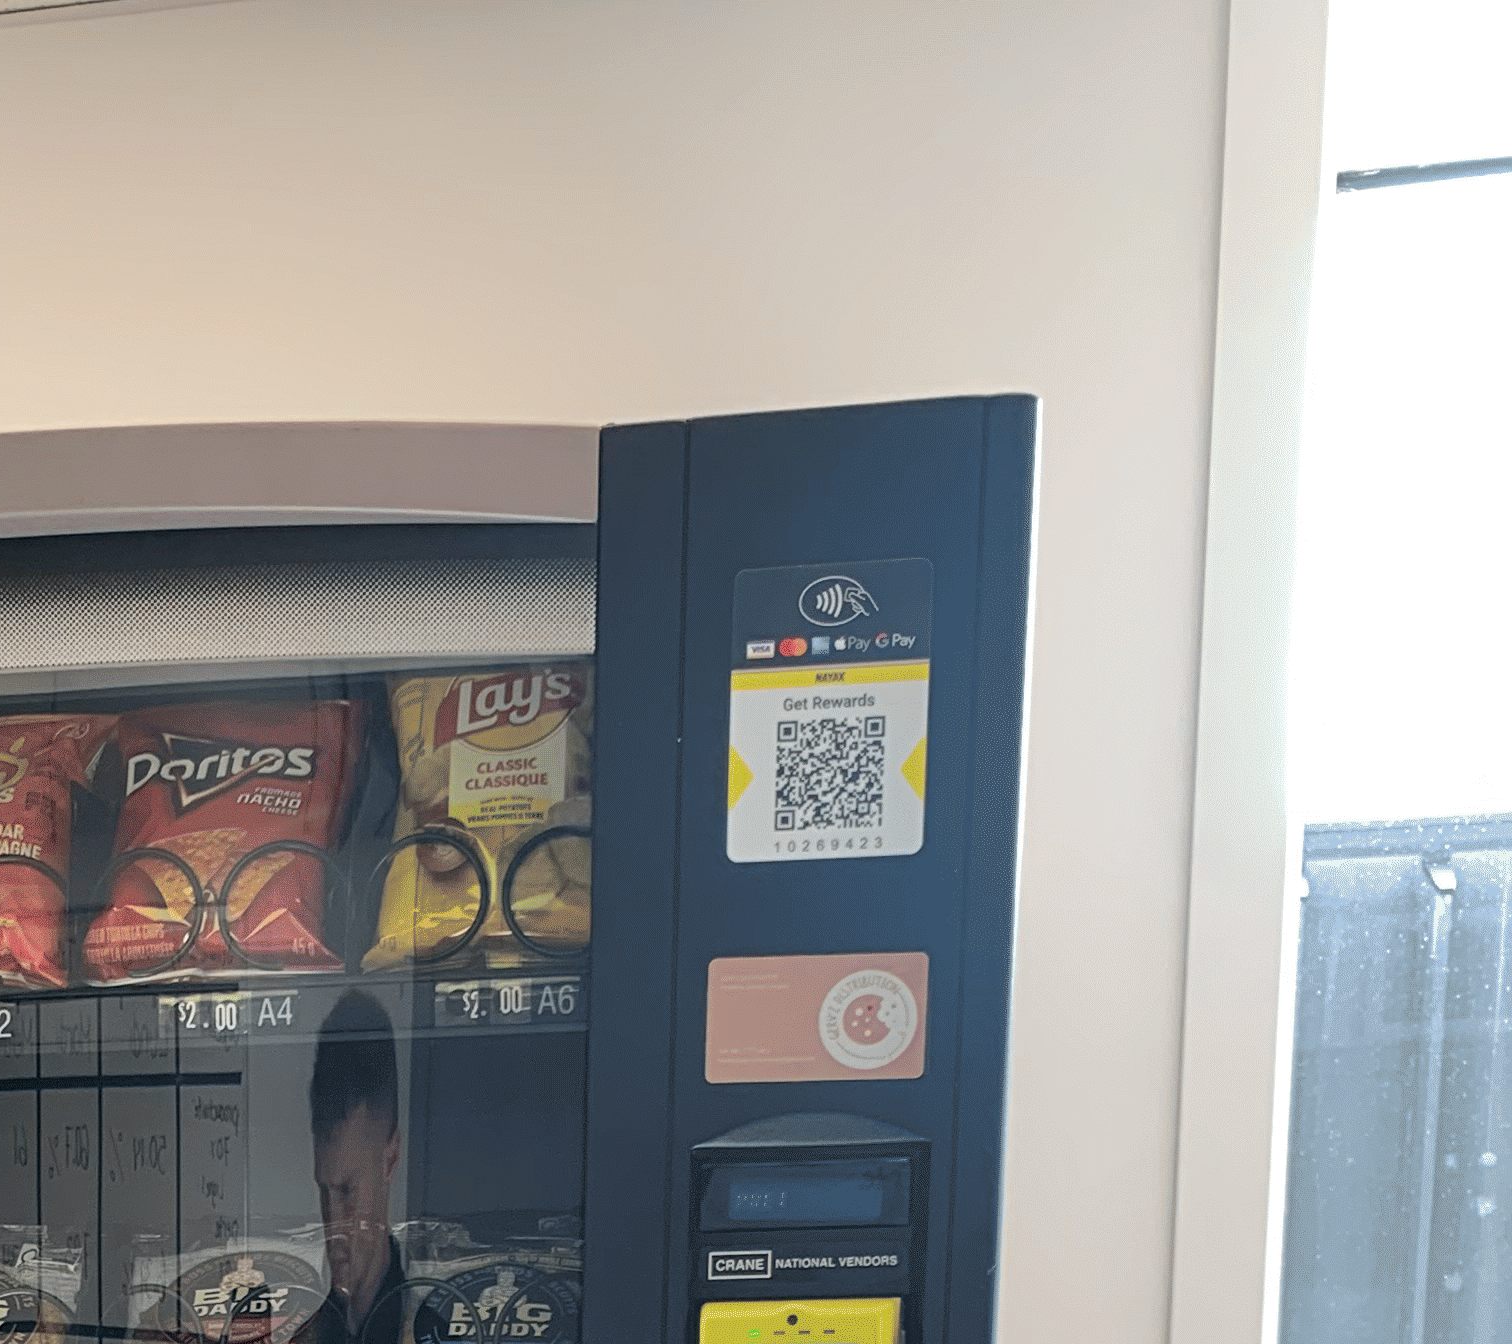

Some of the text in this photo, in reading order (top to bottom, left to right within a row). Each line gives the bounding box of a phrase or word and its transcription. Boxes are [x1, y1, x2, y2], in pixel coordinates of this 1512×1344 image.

[847, 635, 872, 652] Pay
[892, 633, 916, 649] Pay
[457, 669, 571, 735] Lay's
[782, 693, 876, 712] Get Rewards
[126, 747, 314, 796] Doritos
[477, 757, 538, 774] CLASSIC
[465, 773, 548, 790] CLASSIQUE
[774, 837, 884, 854] 10269423
[537, 984, 575, 1016] A6
[258, 997, 293, 1027] A4
[715, 1255, 899, 1273] CRANE NATIONAL VENDORS
[193, 1299, 288, 1317] DADY
